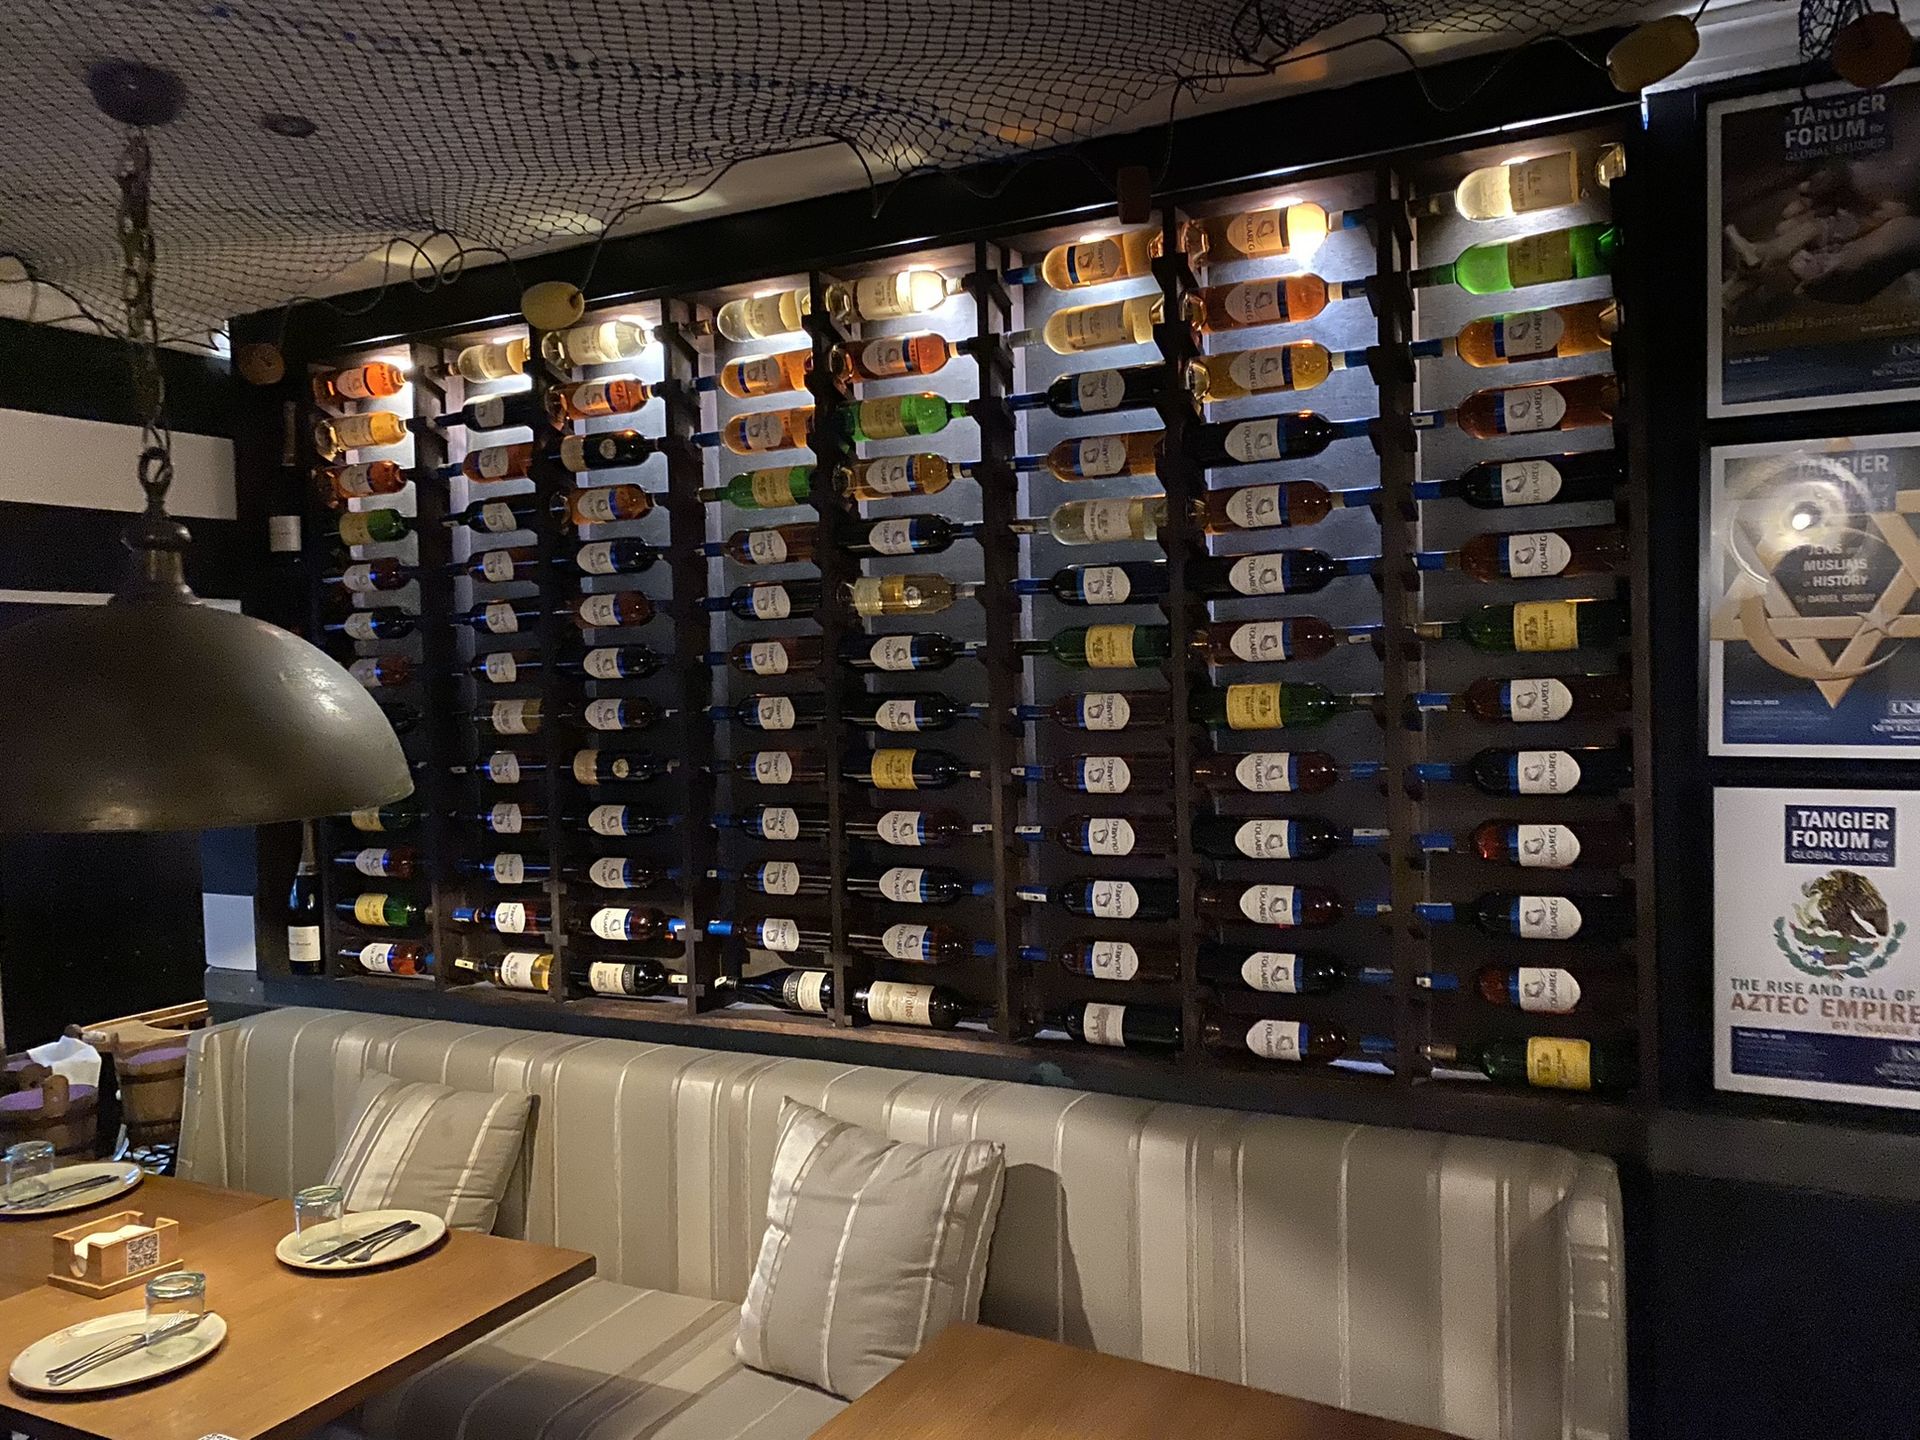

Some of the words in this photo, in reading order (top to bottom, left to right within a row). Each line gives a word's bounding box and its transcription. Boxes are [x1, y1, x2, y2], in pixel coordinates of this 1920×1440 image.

[1791, 93, 1887, 126] TANGIER
[1785, 118, 1866, 149] FORUM
[1535, 311, 1544, 349] TOUAREG
[1535, 388, 1544, 428] TOUAREG
[1531, 463, 1540, 502] TOUAREG
[1540, 535, 1549, 574] TOUAREG
[1803, 558, 1868, 572] MUSLIMS
[1813, 574, 1869, 588] HISTORY
[1249, 626, 1260, 661] TOUAREG
[1105, 695, 1115, 729] TOUAREG
[1106, 758, 1116, 792] TOUAREG
[1256, 755, 1264, 790] TOUAREG
[1549, 752, 1558, 790] TOUAREG
[1111, 820, 1120, 854] TOUAREG
[1797, 811, 1890, 830] TANGIER
[1255, 822, 1265, 858] TOUAREG
[1791, 830, 1870, 850] FORUM
[1872, 838, 1889, 849] for
[1791, 849, 1836, 862] GLOBAL
[1839, 851, 1890, 863] STUDIES
[1114, 883, 1124, 917] TOUAREG
[1260, 887, 1269, 922] TOUAREG
[1550, 899, 1559, 938] TOUAREG
[1114, 944, 1124, 978] TOUAREG
[1261, 955, 1271, 991] TOUAREG
[1549, 971, 1558, 1009] TOUAREG
[1730, 977, 1761, 992] THE
[1766, 979, 1804, 995] RISE
[1808, 983, 1844, 997] AND
[1850, 985, 1889, 1001] FALL
[1894, 989, 1917, 1002] OF
[1731, 992, 1810, 1017] AZTEC
[1821, 998, 1920, 1025] EMPIRE
